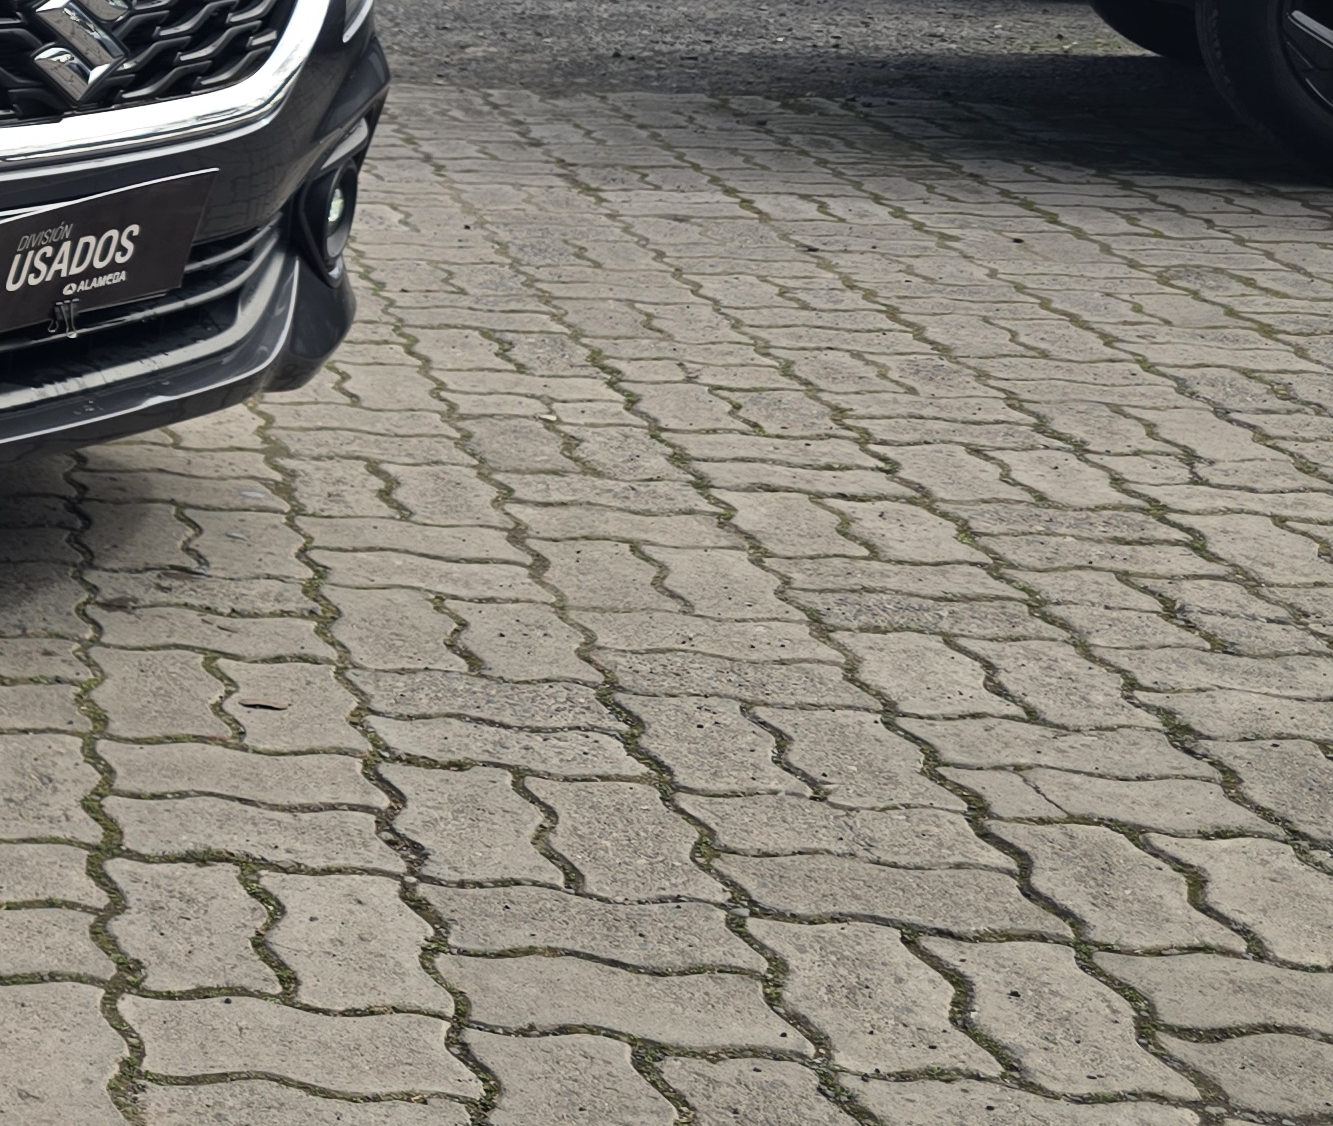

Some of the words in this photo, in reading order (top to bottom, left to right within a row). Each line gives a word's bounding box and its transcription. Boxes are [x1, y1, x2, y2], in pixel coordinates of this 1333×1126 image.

[17, 222, 73, 251] DIVISIÓN
[5, 224, 140, 292] USADOS
[76, 271, 126, 292] ALAMEDA
